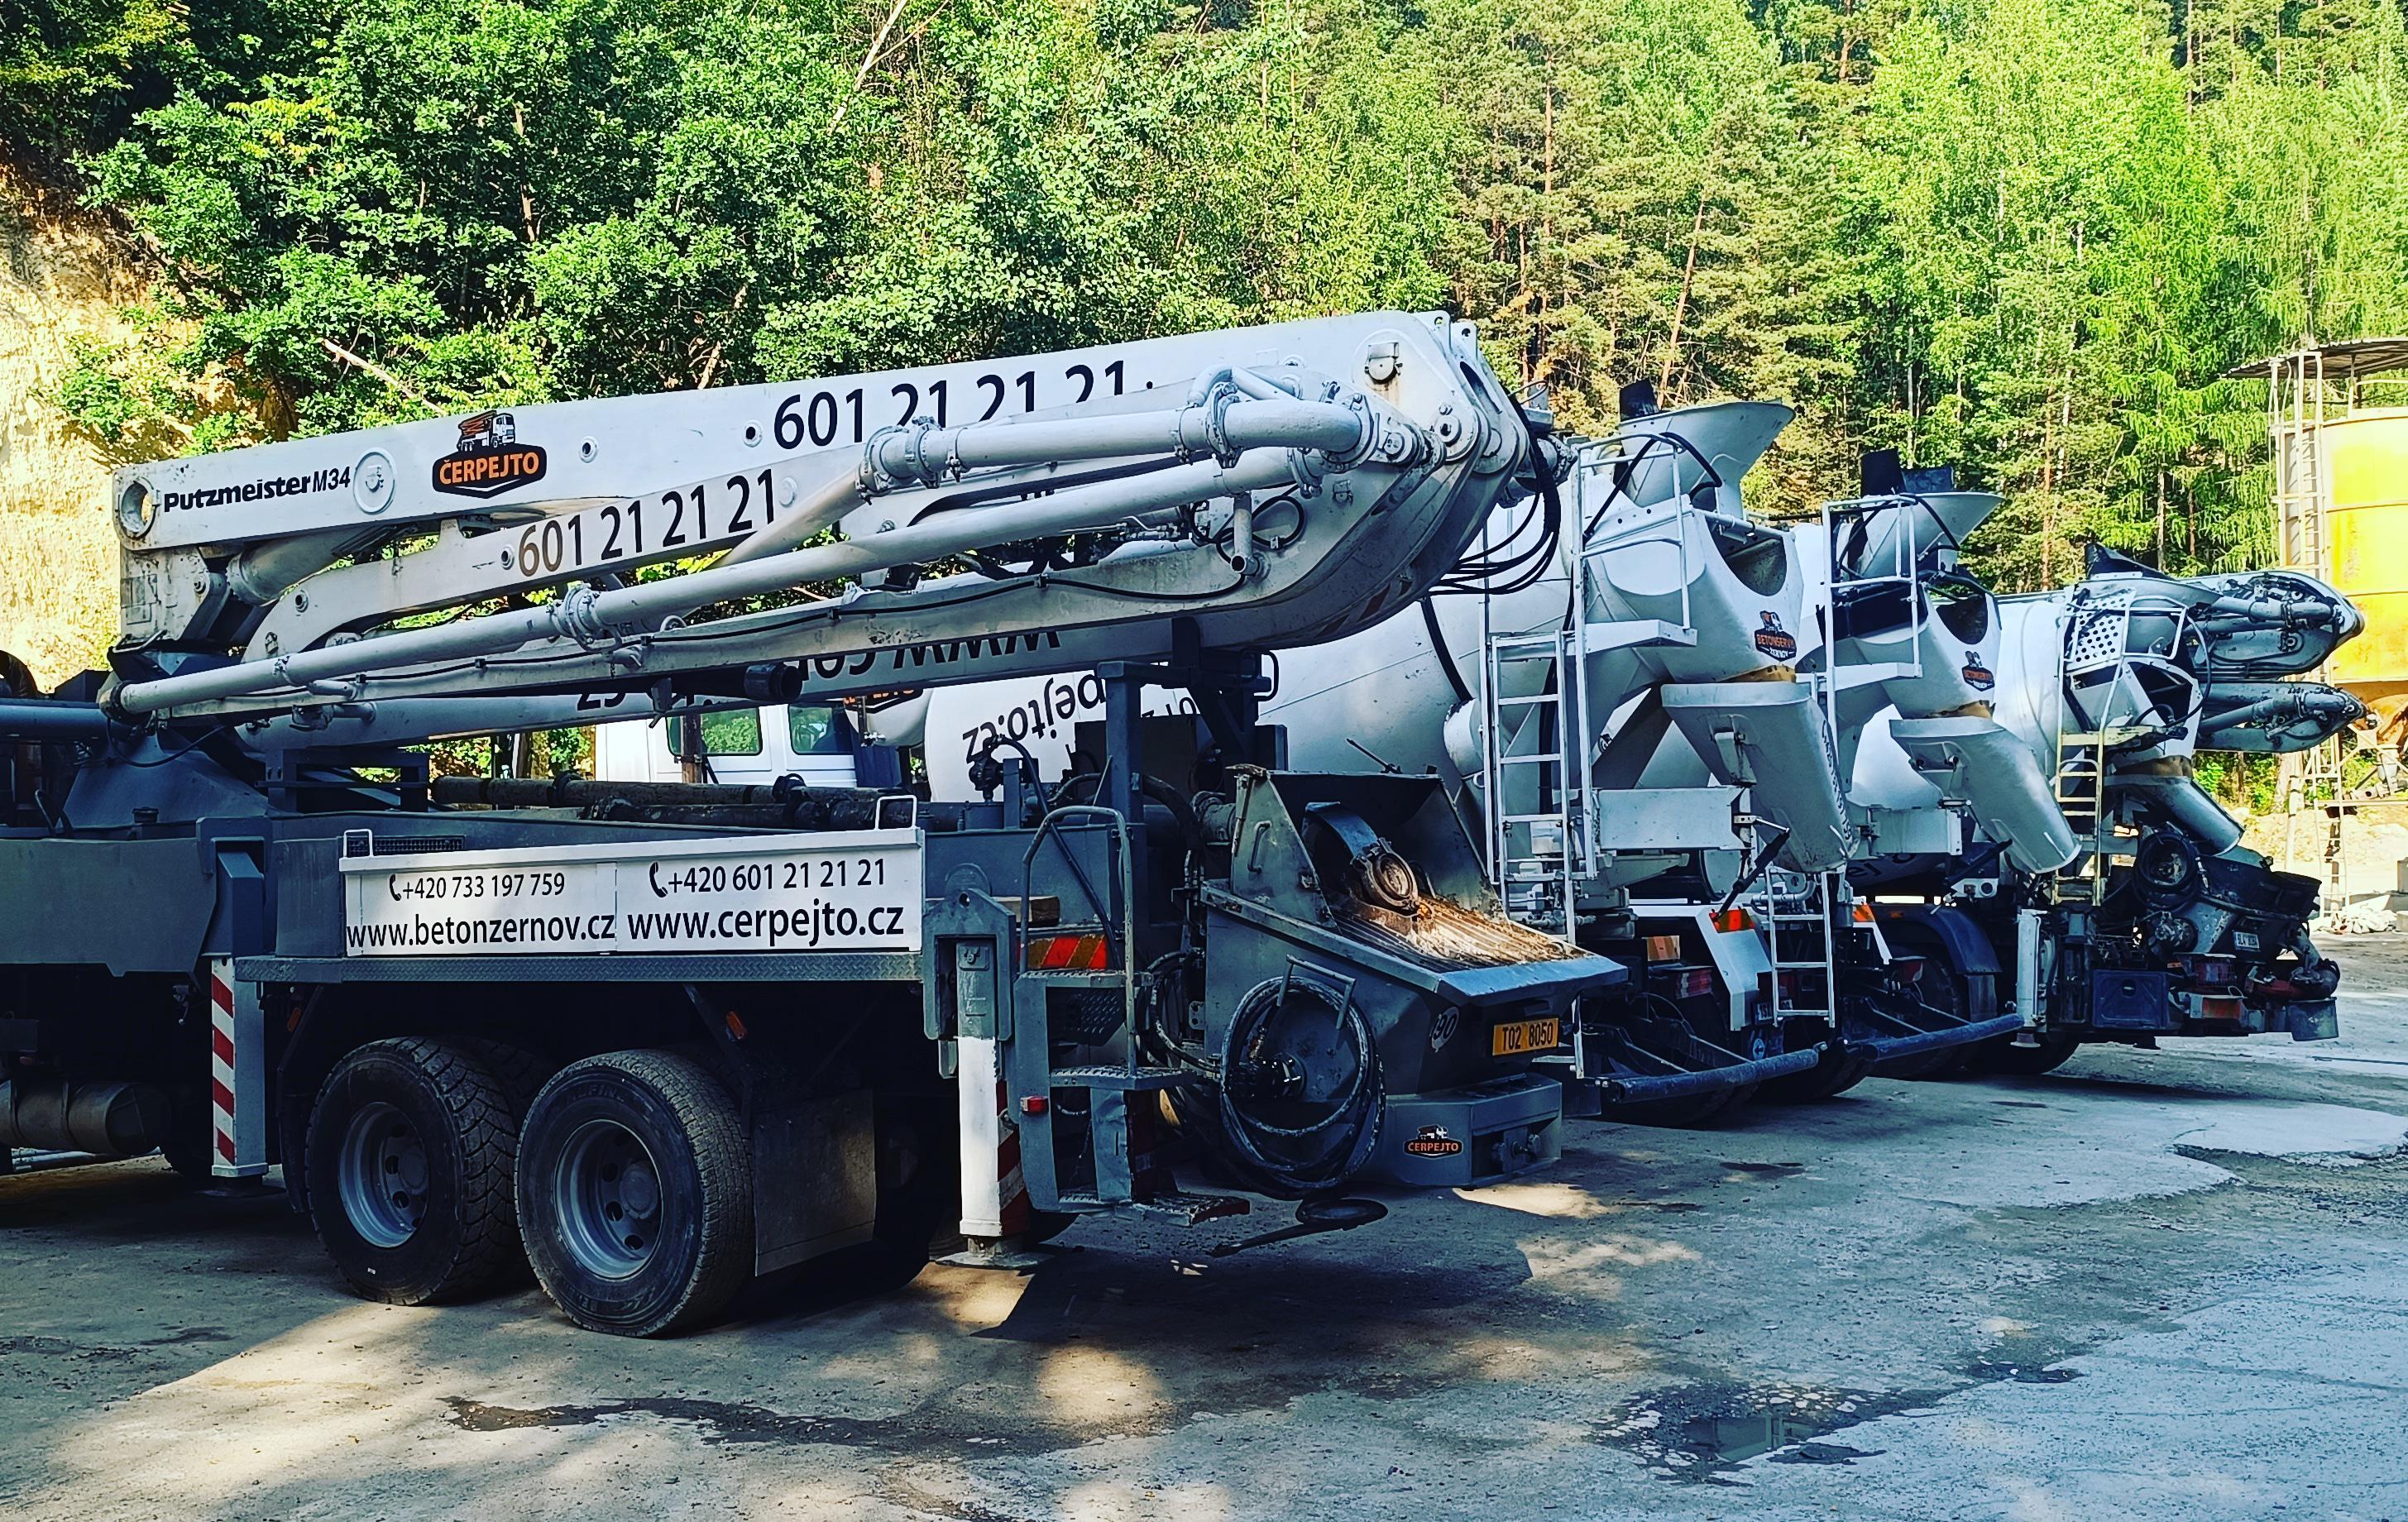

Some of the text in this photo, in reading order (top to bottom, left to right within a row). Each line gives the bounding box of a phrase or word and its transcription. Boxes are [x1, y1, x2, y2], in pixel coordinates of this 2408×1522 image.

[774, 360, 1124, 450] 601 21 21 21
[438, 451, 540, 486] ČERPEJTO
[164, 466, 352, 513] Putzmeister M34
[519, 468, 774, 577] 601 21 21 21
[402, 872, 566, 899] +420 733 197 759
[668, 858, 884, 894] +420 601 21 21 21
[346, 913, 616, 948] www.betonzernov.cz
[627, 898, 905, 947] www.cerpejto.cz
[1502, 1022, 1554, 1051] T02 8050
